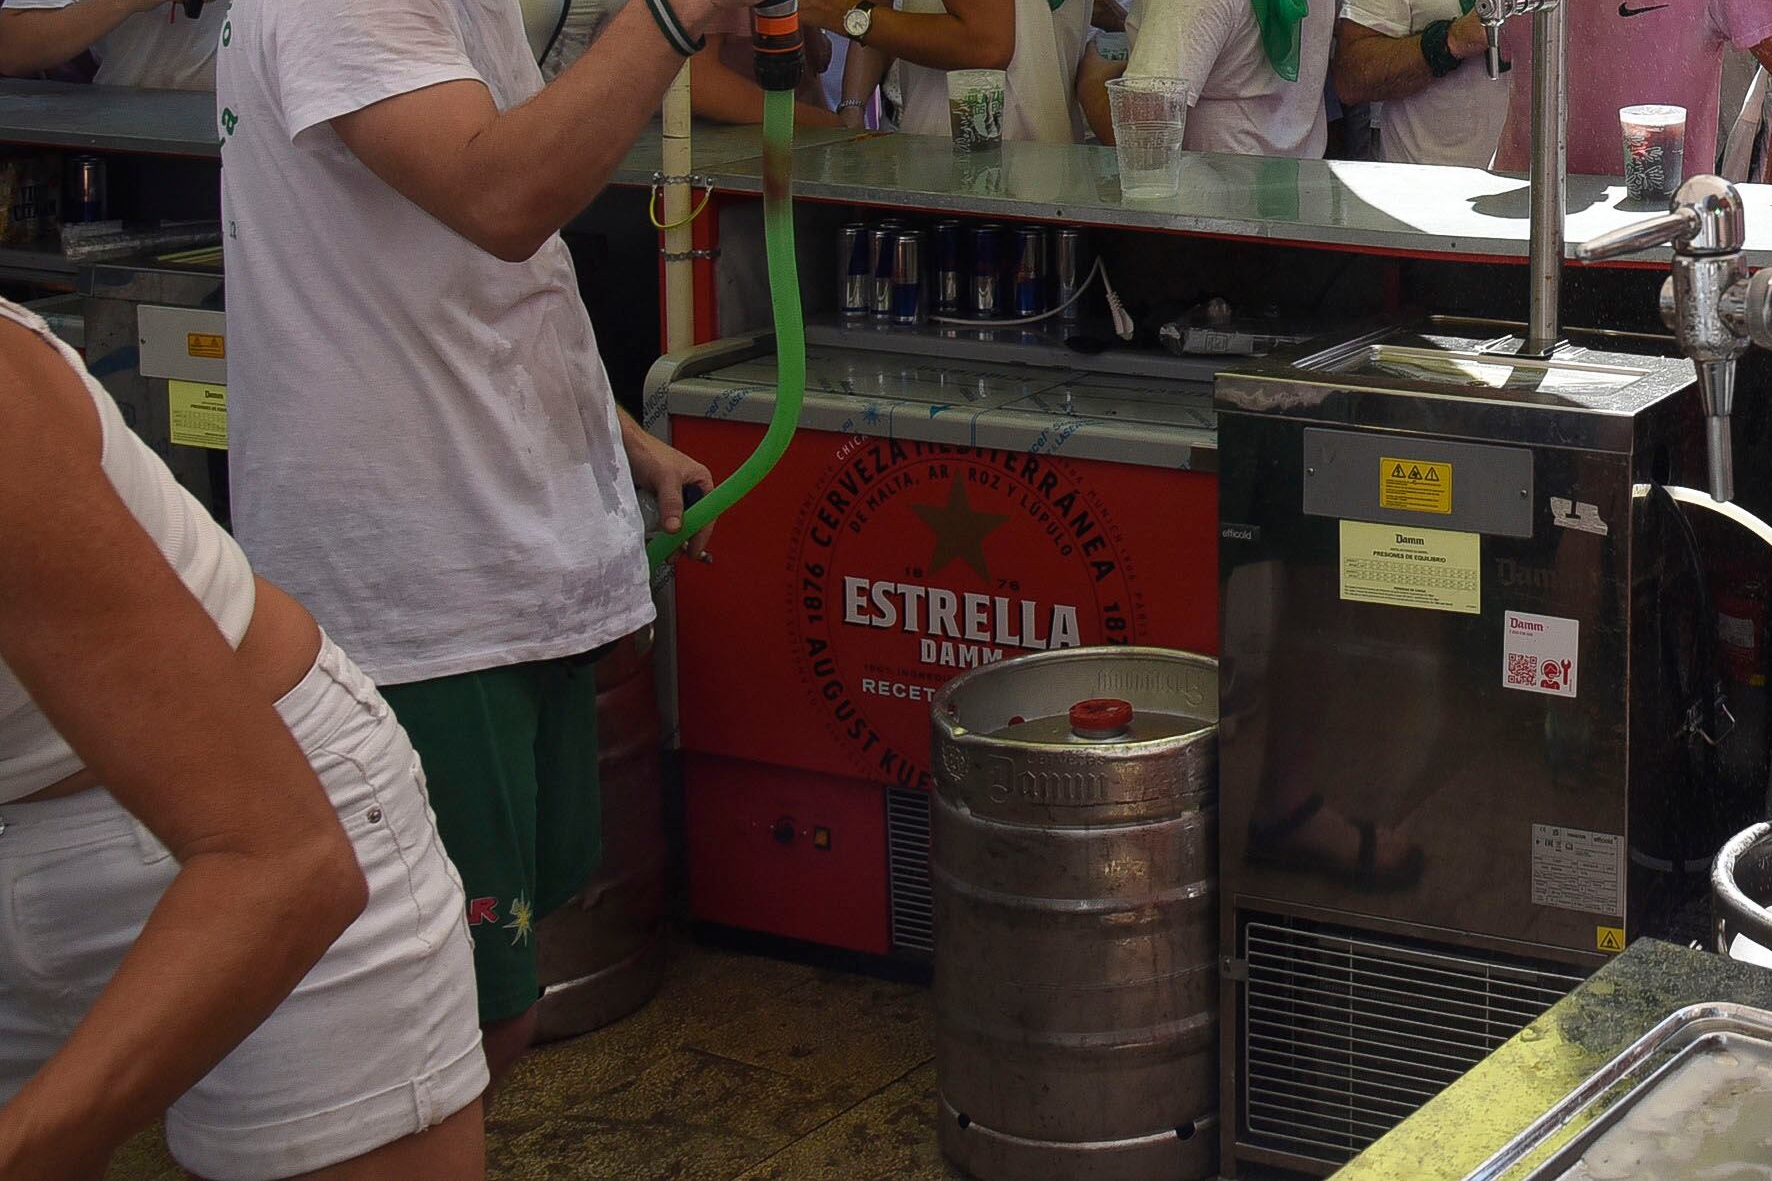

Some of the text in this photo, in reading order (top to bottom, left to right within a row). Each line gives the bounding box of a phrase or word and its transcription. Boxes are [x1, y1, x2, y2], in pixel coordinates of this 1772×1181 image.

[811, 437, 908, 548] CERVEZA
[849, 510, 868, 533] DE
[1007, 483, 1017, 497] Y
[1221, 527, 1252, 541] efficold
[1395, 533, 1425, 545] Damm
[1372, 550, 1405, 560] PRESIONES
[1414, 554, 1447, 563] EQUILIBRIO
[843, 574, 1082, 651] ESTRELLA
[1509, 616, 1544, 632] Damm
[919, 637, 1003, 670] DAMM
[805, 635, 881, 754] AUGUST
[861, 676, 936, 703] RECET
